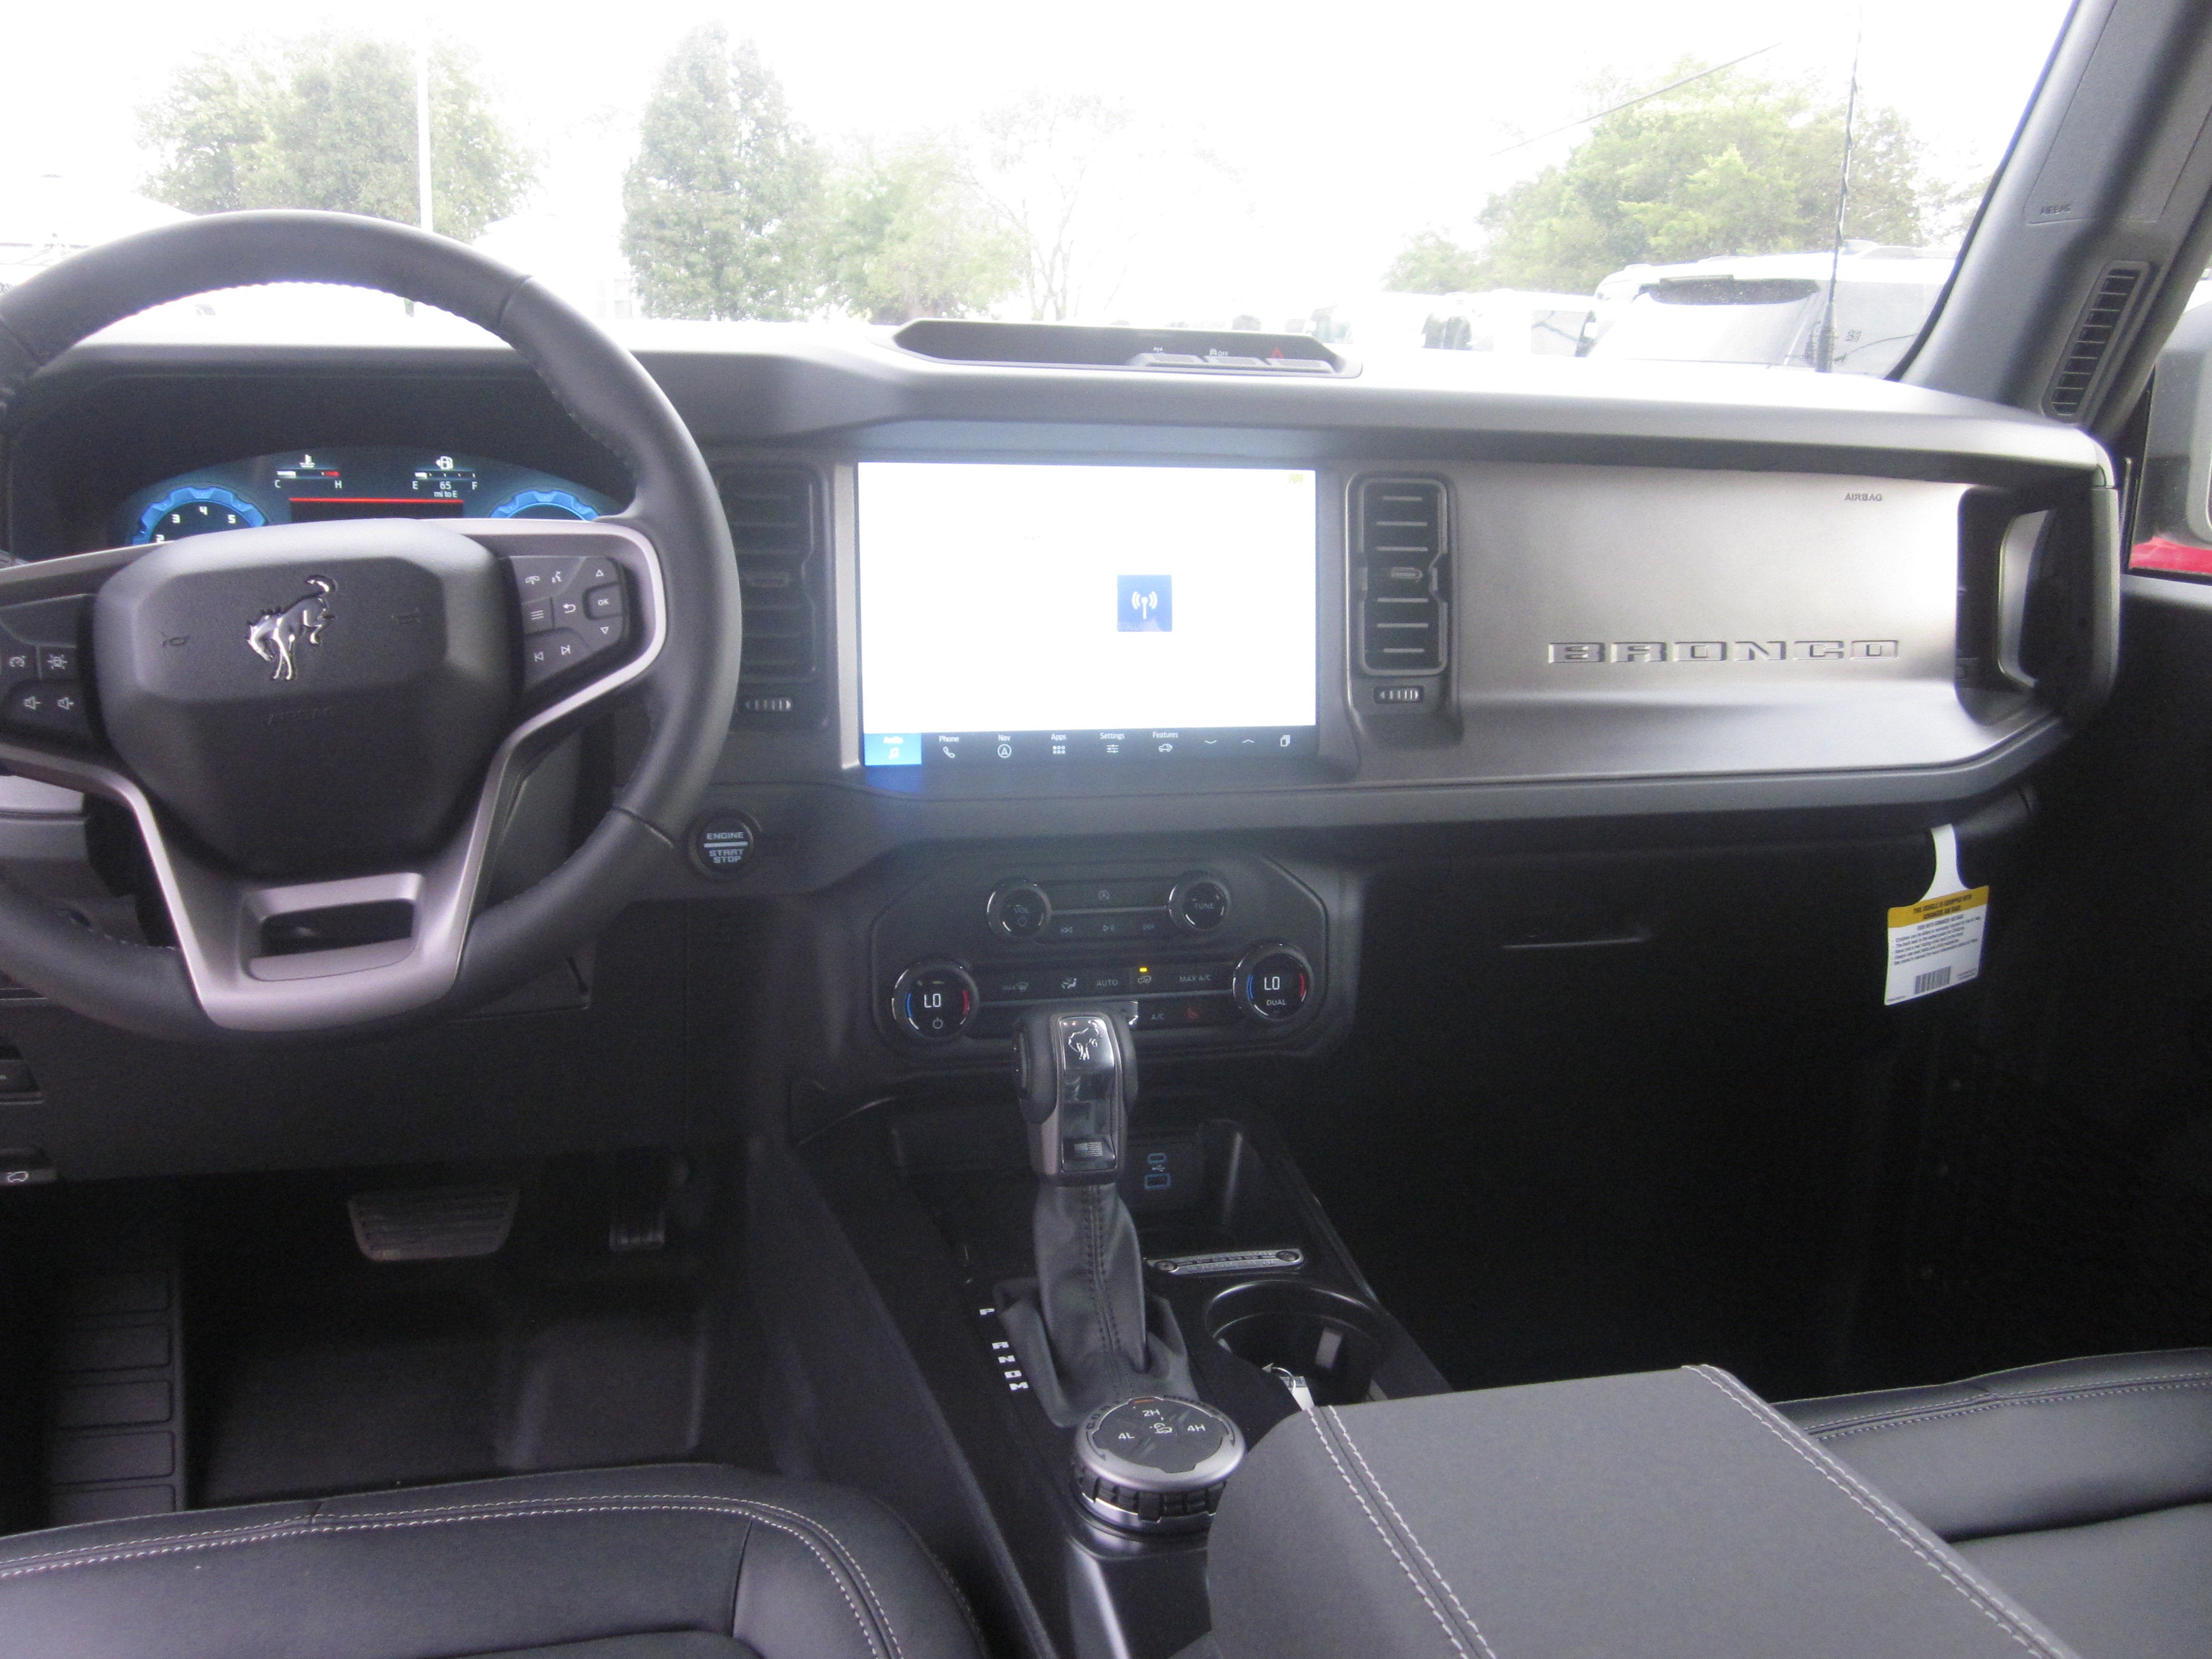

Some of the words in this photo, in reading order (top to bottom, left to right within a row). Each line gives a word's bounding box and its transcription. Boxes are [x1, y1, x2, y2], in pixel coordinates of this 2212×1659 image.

[274, 479, 281, 488] C
[334, 480, 342, 489] H
[412, 481, 419, 489] E
[440, 481, 452, 490] 65
[472, 481, 478, 490] F
[199, 505, 208, 515] 4
[171, 514, 181, 524] 3
[227, 514, 236, 524] 5
[1548, 639, 1899, 663] BRONCO
[706, 831, 744, 840] ENGINE
[709, 848, 744, 857] START
[713, 855, 742, 864] STOP
[1264, 976, 1280, 990] LO
[924, 993, 941, 1008] LO
[992, 1341, 1010, 1349] R
[998, 1355, 1016, 1363] N
[1004, 1370, 1022, 1379] D
[1009, 1381, 1029, 1390] M
[1187, 1424, 1206, 1432] 4H
[1118, 1432, 1135, 1440] 4L
